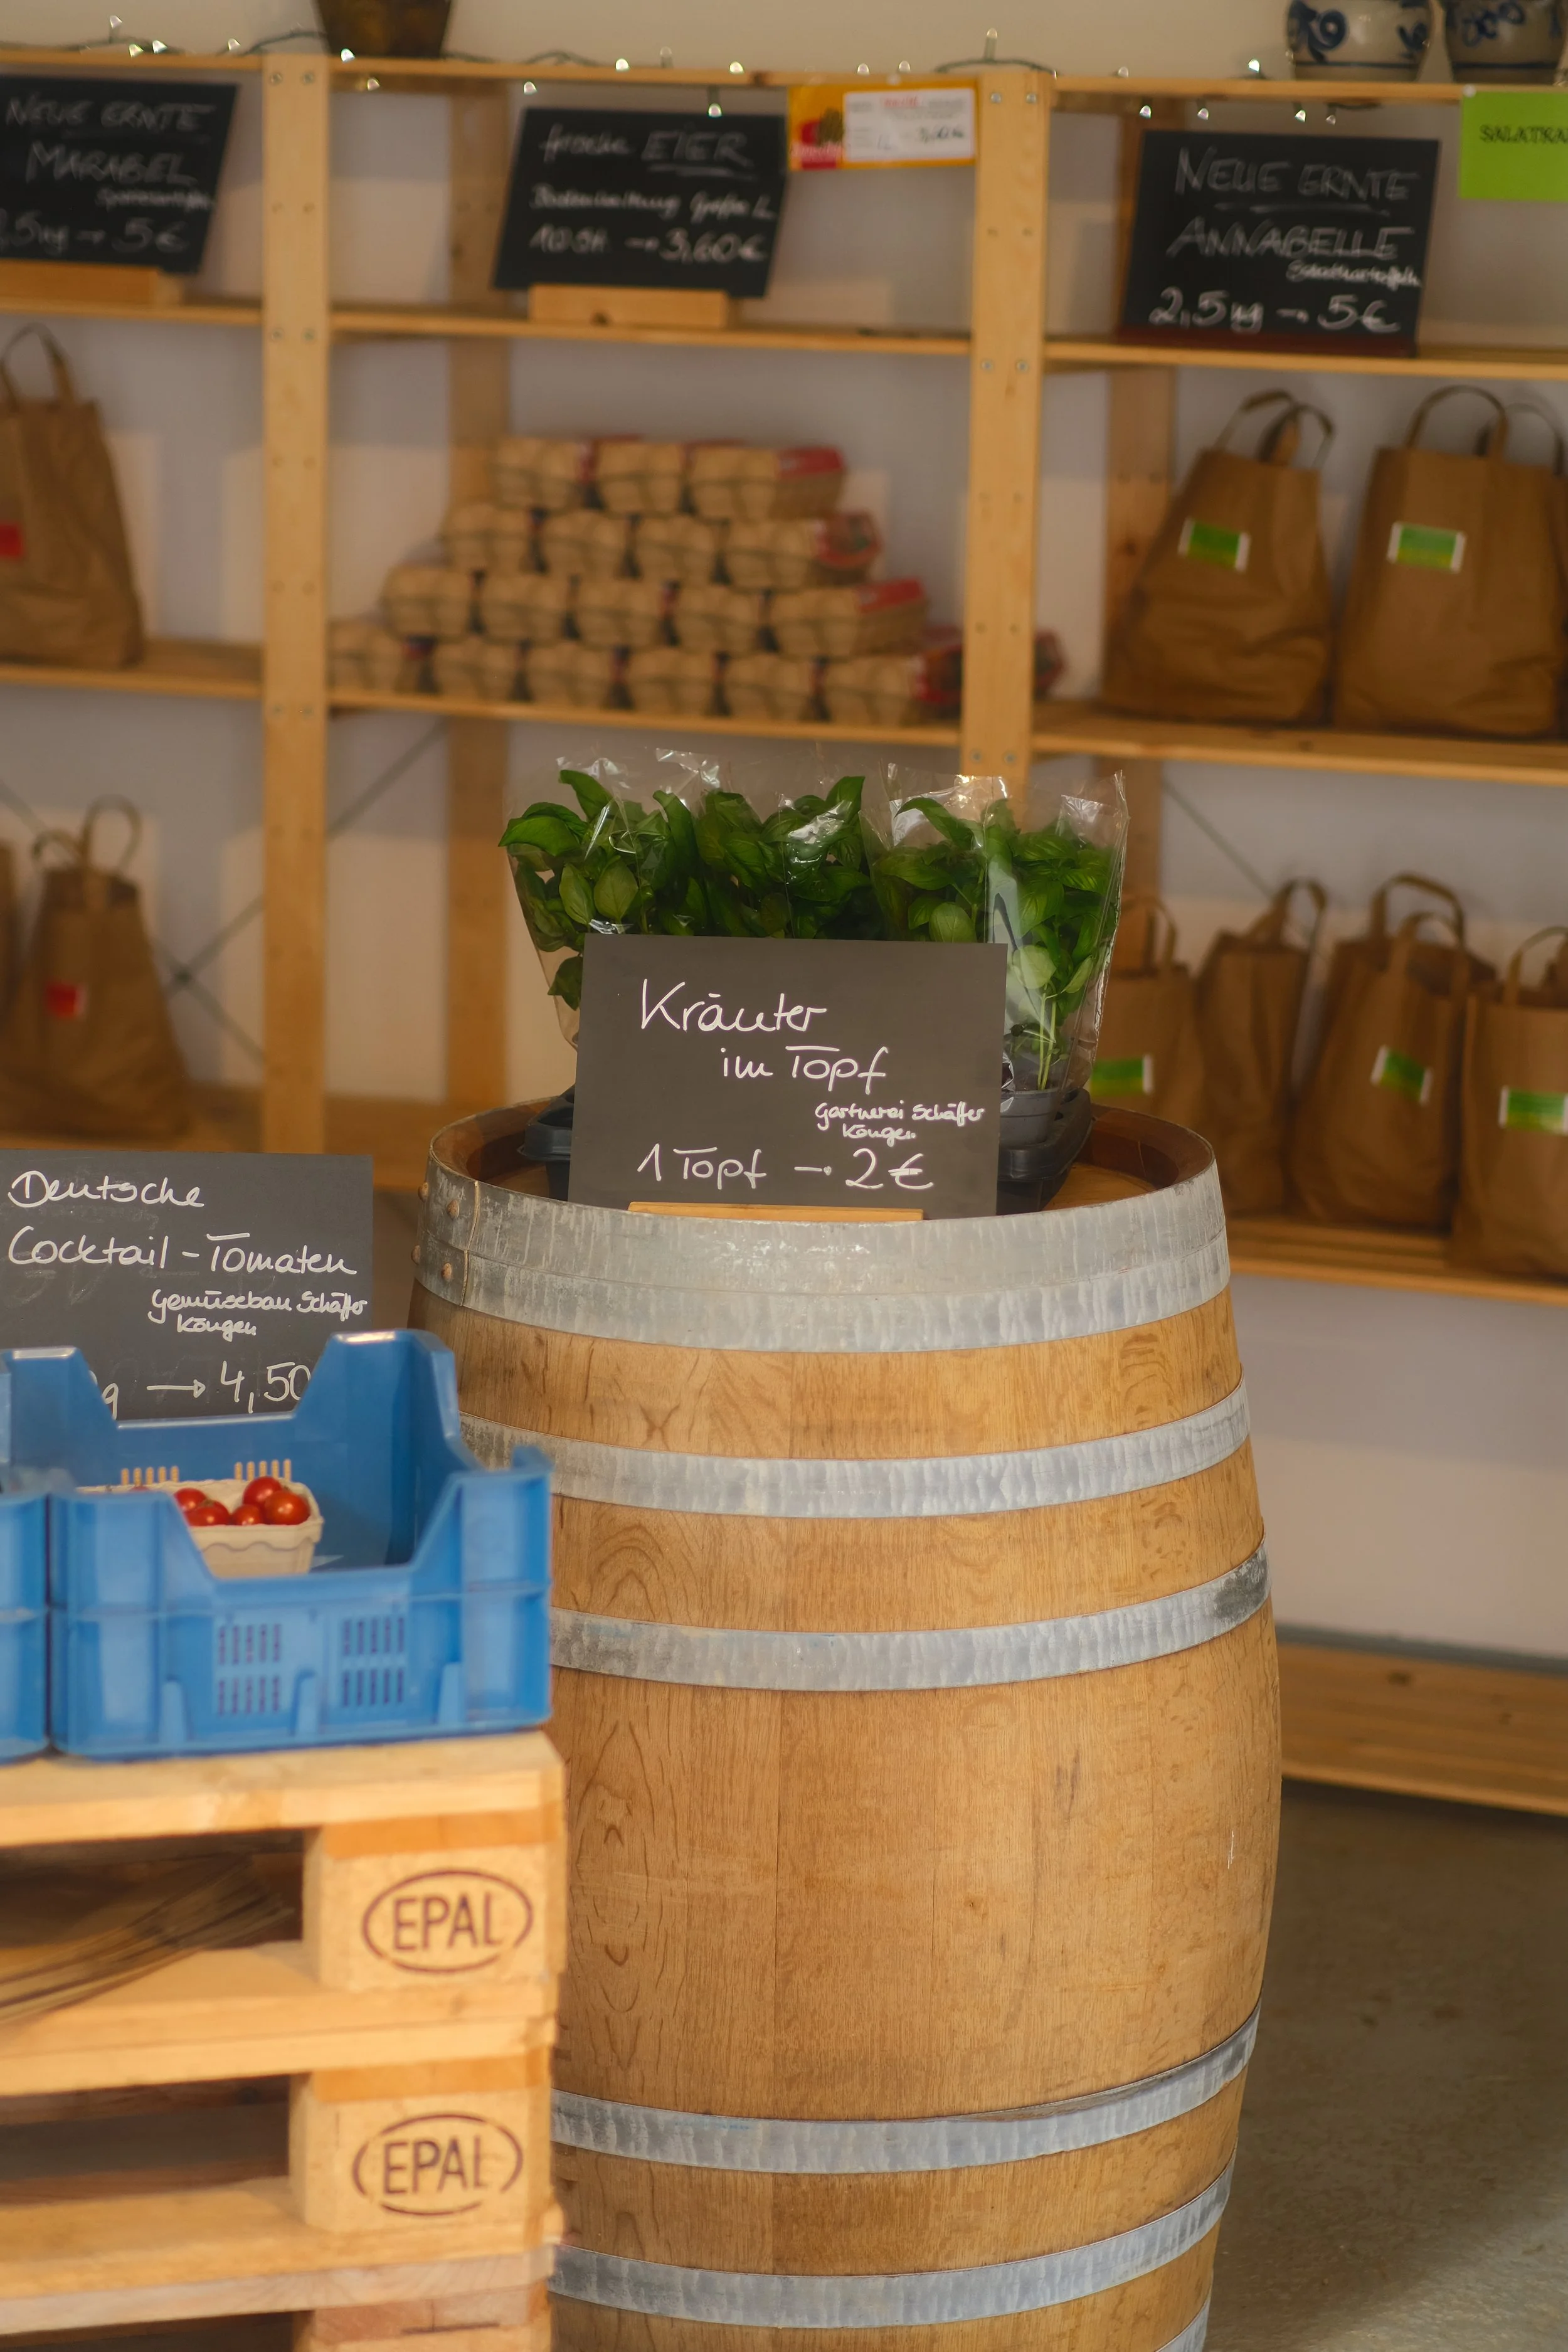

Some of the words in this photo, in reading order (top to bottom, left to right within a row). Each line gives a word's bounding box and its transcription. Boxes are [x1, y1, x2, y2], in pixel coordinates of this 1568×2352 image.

[641, 130, 754, 168] EIER
[1174, 146, 1291, 196] NEUE
[1296, 163, 1422, 202] ERNTE
[751, 194, 778, 221] L
[1165, 216, 1415, 260] ANNABELLE
[1318, 293, 1401, 333] 5€
[640, 978, 827, 1032] Kräuter
[721, 1047, 773, 1079] im
[785, 1046, 889, 1094] Topf
[637, 1143, 662, 1182] 1
[673, 1147, 767, 1190] Topf
[8, 1170, 204, 1208] Deutsche
[206, 1232, 357, 1274] Tomaten
[177, 1313, 257, 1342] Köngen
[393, 1892, 505, 1952] EPAL
[383, 2136, 490, 2196] EPAL
